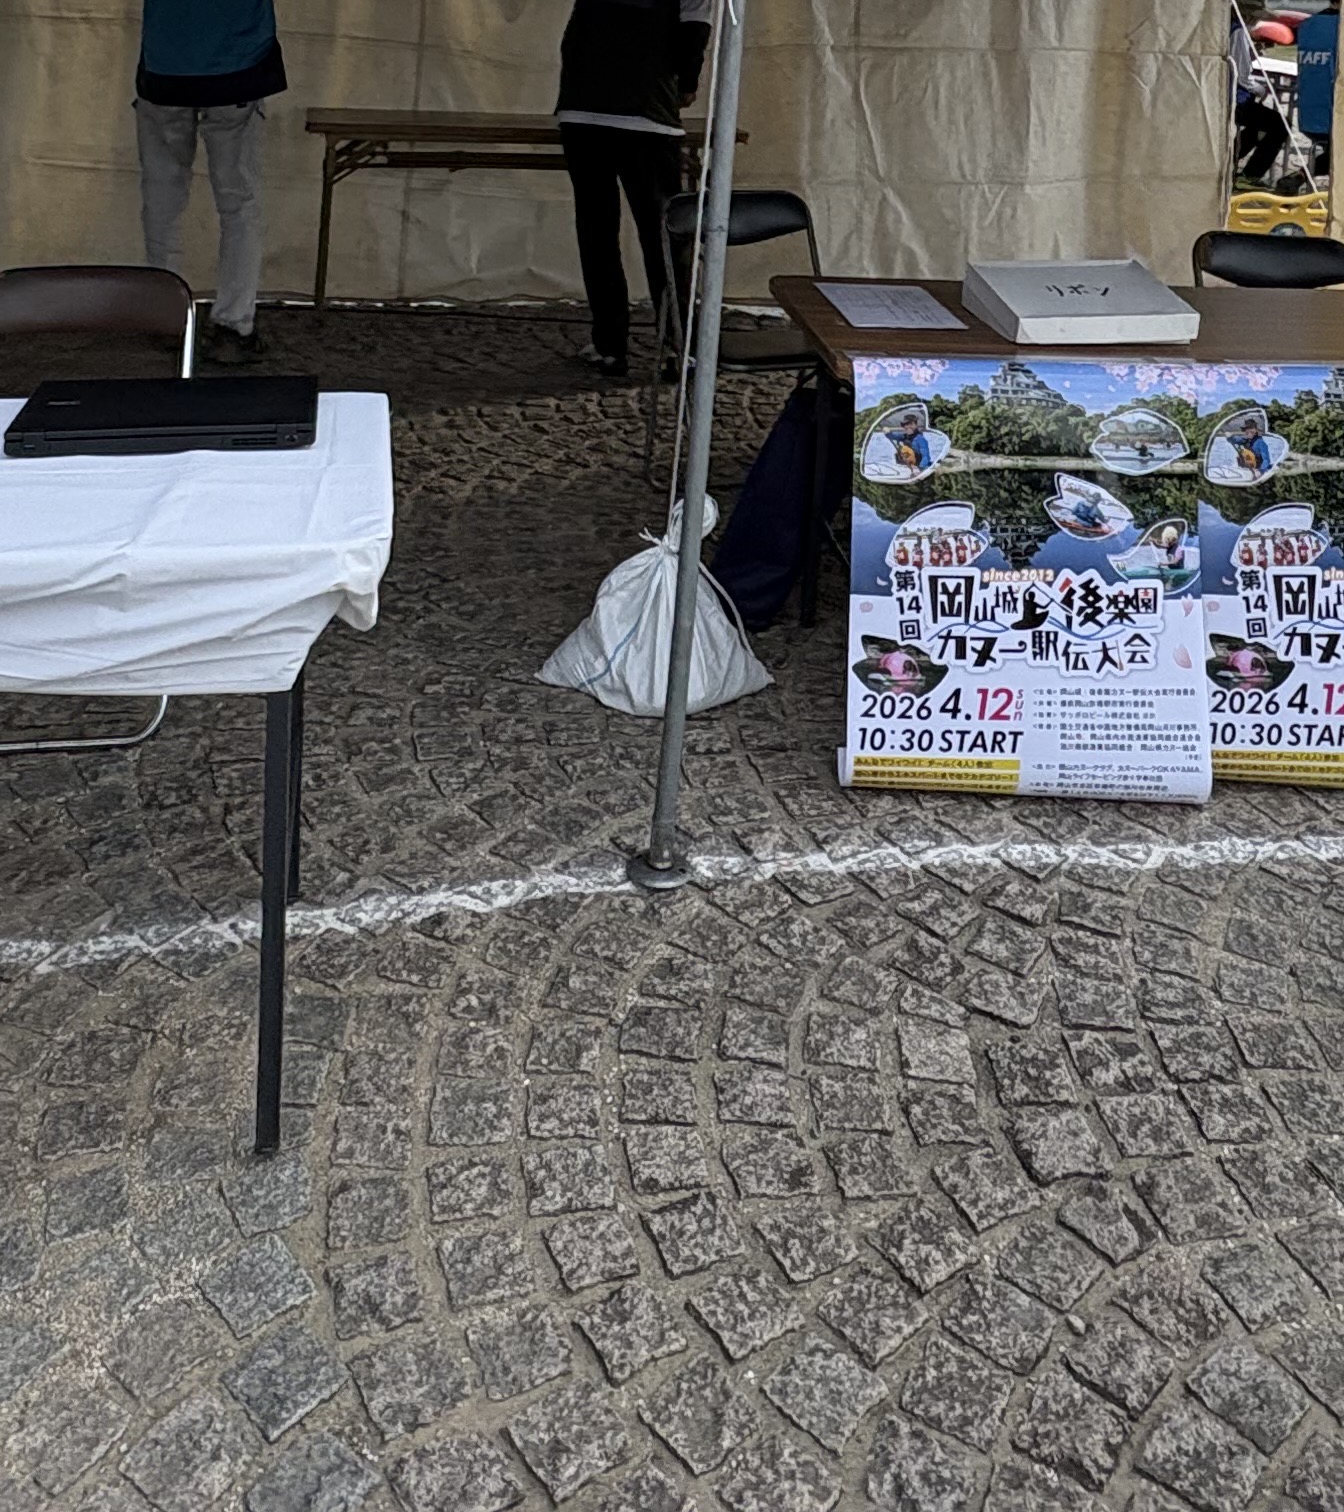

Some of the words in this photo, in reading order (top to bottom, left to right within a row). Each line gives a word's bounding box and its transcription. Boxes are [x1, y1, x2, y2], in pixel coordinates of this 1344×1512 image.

[1298, 50, 1332, 65] TAFF
[982, 568, 1054, 582] since2012
[937, 630, 1152, 674] カヌー駅伝大会
[860, 694, 932, 720] 2026
[939, 687, 1014, 721] 4.12
[1210, 690, 1280, 715] 2026
[858, 727, 934, 752] 10:30
[938, 730, 1024, 754] START
[1209, 722, 1282, 745] 10:30
